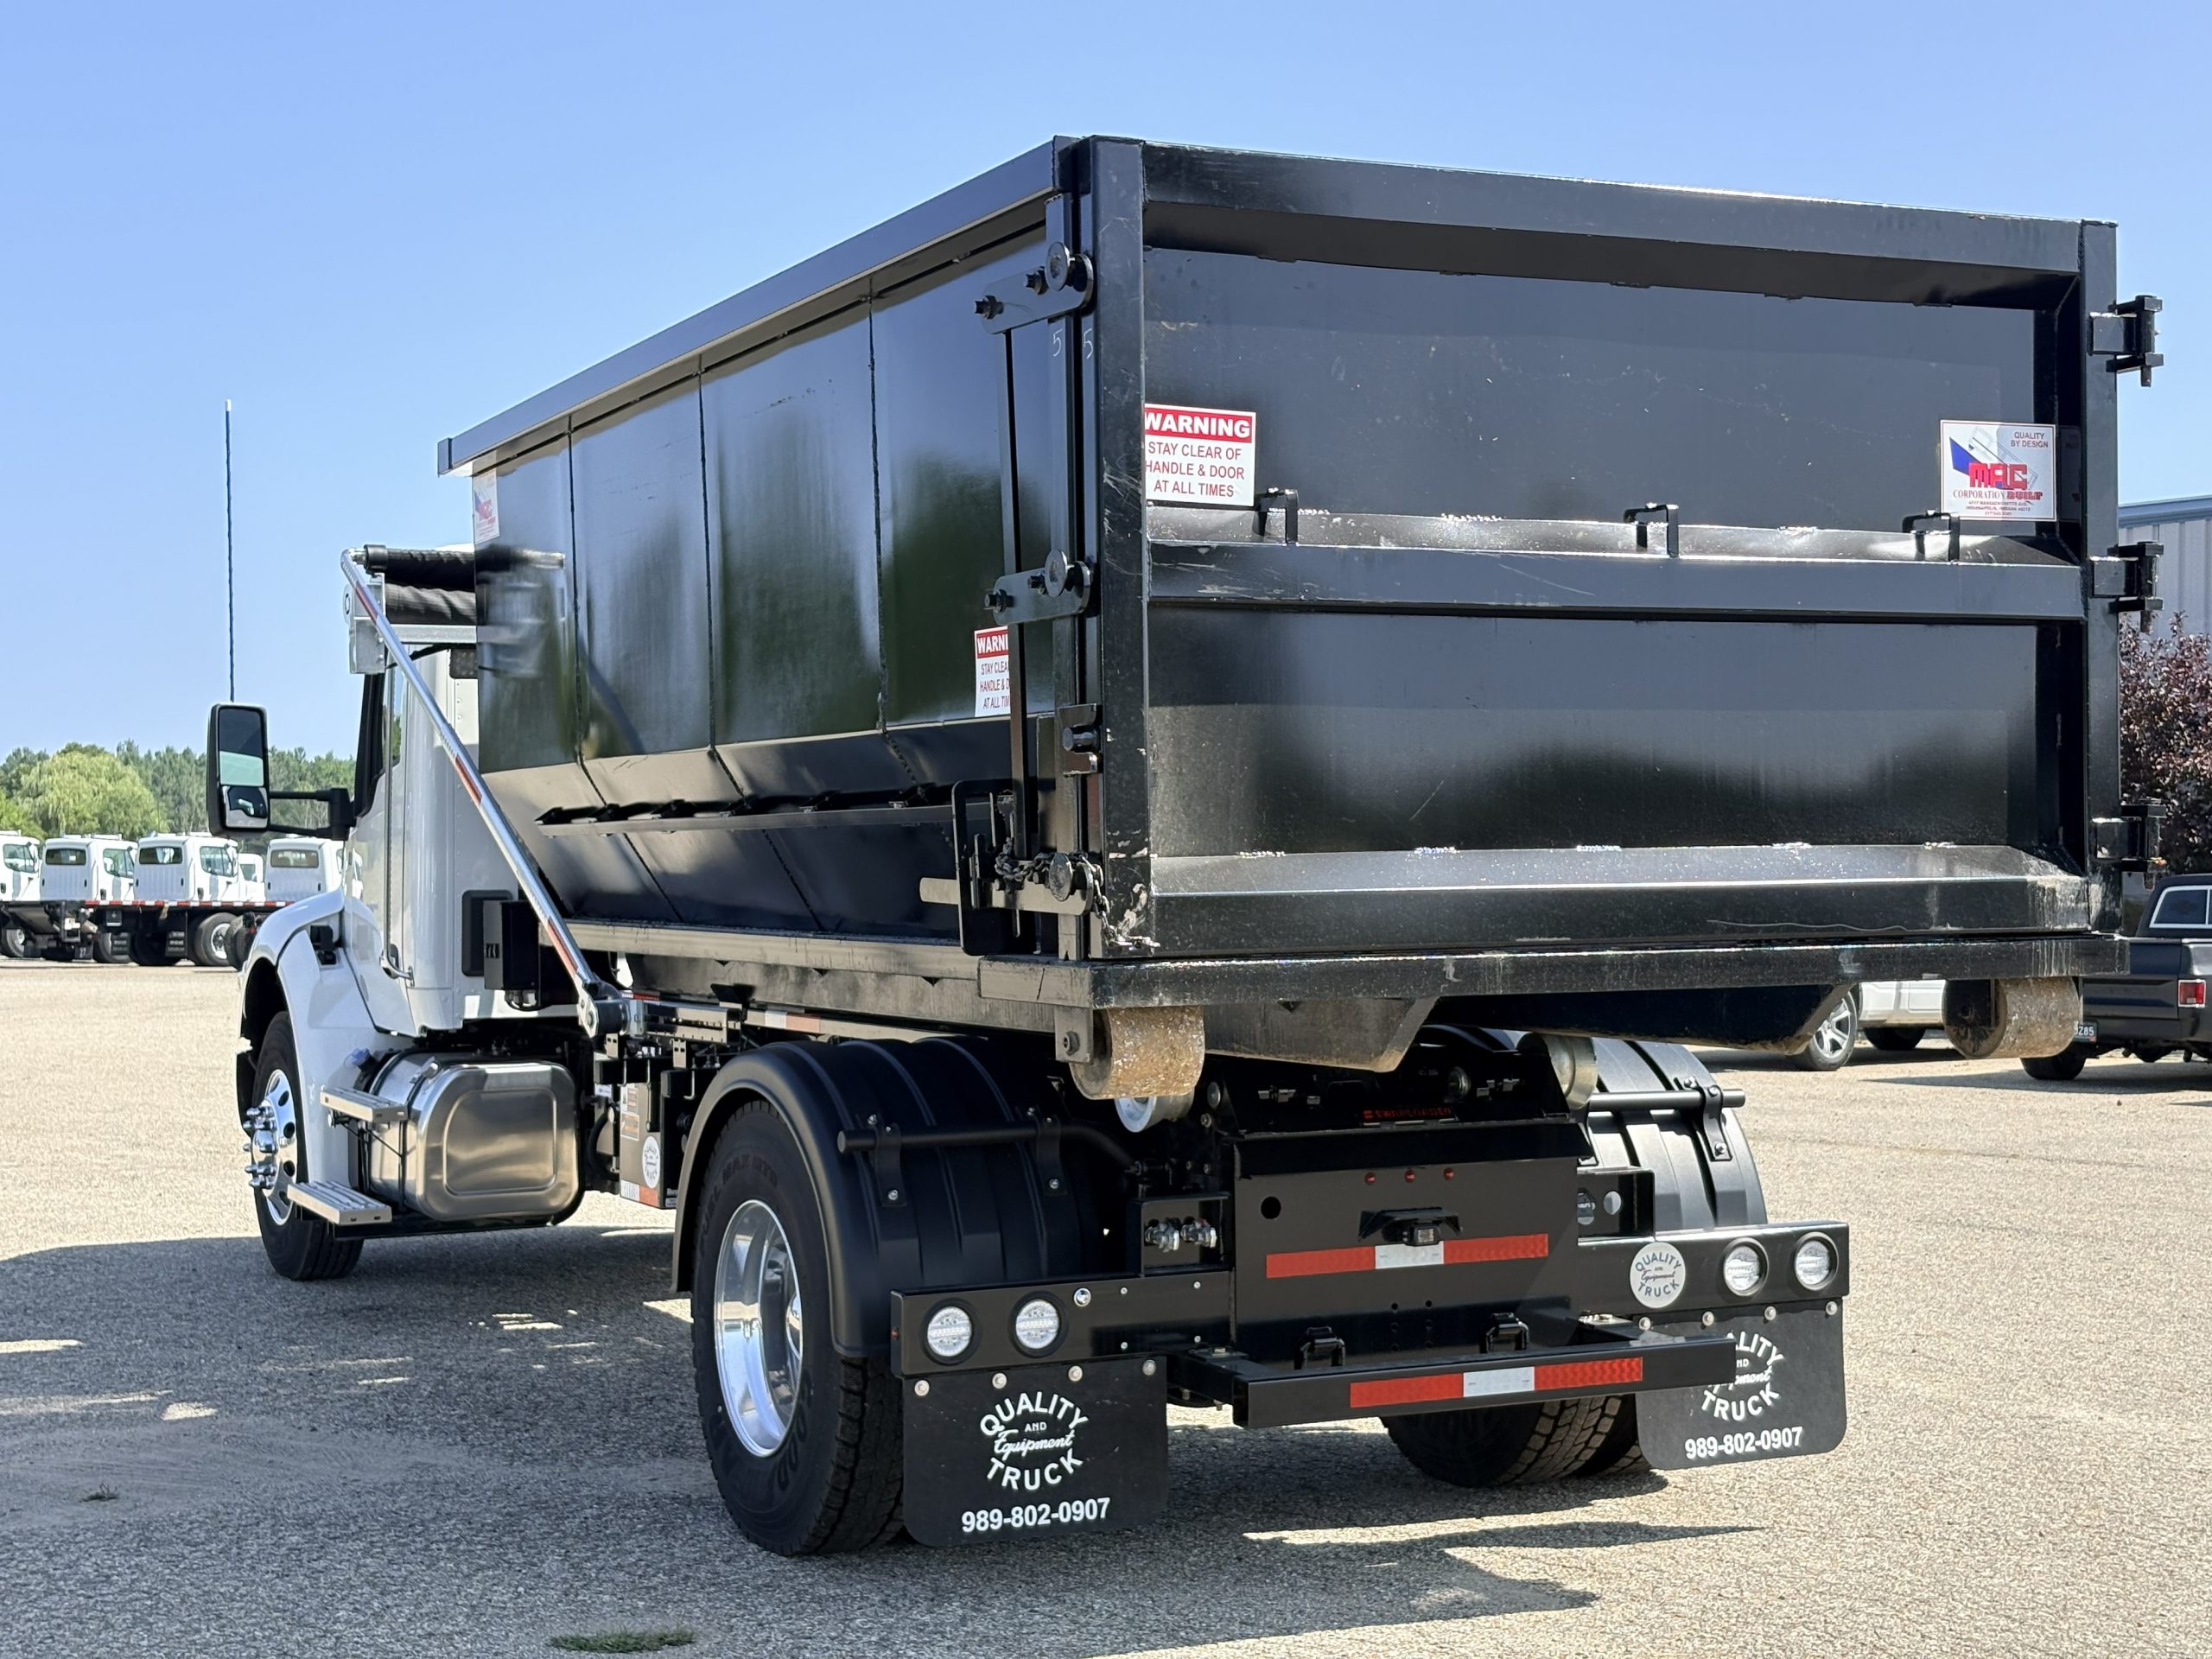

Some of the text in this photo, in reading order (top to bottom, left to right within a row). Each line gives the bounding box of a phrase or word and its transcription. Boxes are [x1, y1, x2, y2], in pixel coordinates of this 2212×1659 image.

[1052, 328, 1063, 357] 5
[1083, 327, 1093, 359] 5
[1145, 412, 1250, 438] WARNING
[2014, 431, 2045, 440] QUALITY
[2022, 440, 2049, 448] DESIGN
[1148, 441, 1242, 461] STAY CLEAR OF
[1146, 461, 1244, 480] HANDLE & DOOR
[1968, 462, 2028, 490] MAC
[1154, 480, 1234, 497] AT ALL TIMES
[977, 633, 1008, 654] WARNI
[981, 661, 1009, 675] STAY CLEA
[980, 679, 1000, 692] HANDLE
[982, 697, 990, 709] AT
[990, 696, 1000, 709] ALL
[1635, 1252, 1681, 1271] QUALITY
[1637, 1279, 1679, 1298] TRUCK
[1737, 1358, 1750, 1368] ND
[1701, 1382, 1780, 1421] TRUCK
[980, 1391, 1090, 1436] QUALITY
[1024, 1421, 1047, 1433] AND
[994, 1428, 1075, 1461] Equipment
[1685, 1426, 1803, 1459] 989-802-0907
[987, 1447, 1084, 1491] TRUCK
[962, 1497, 1110, 1533] 989-802-0907
